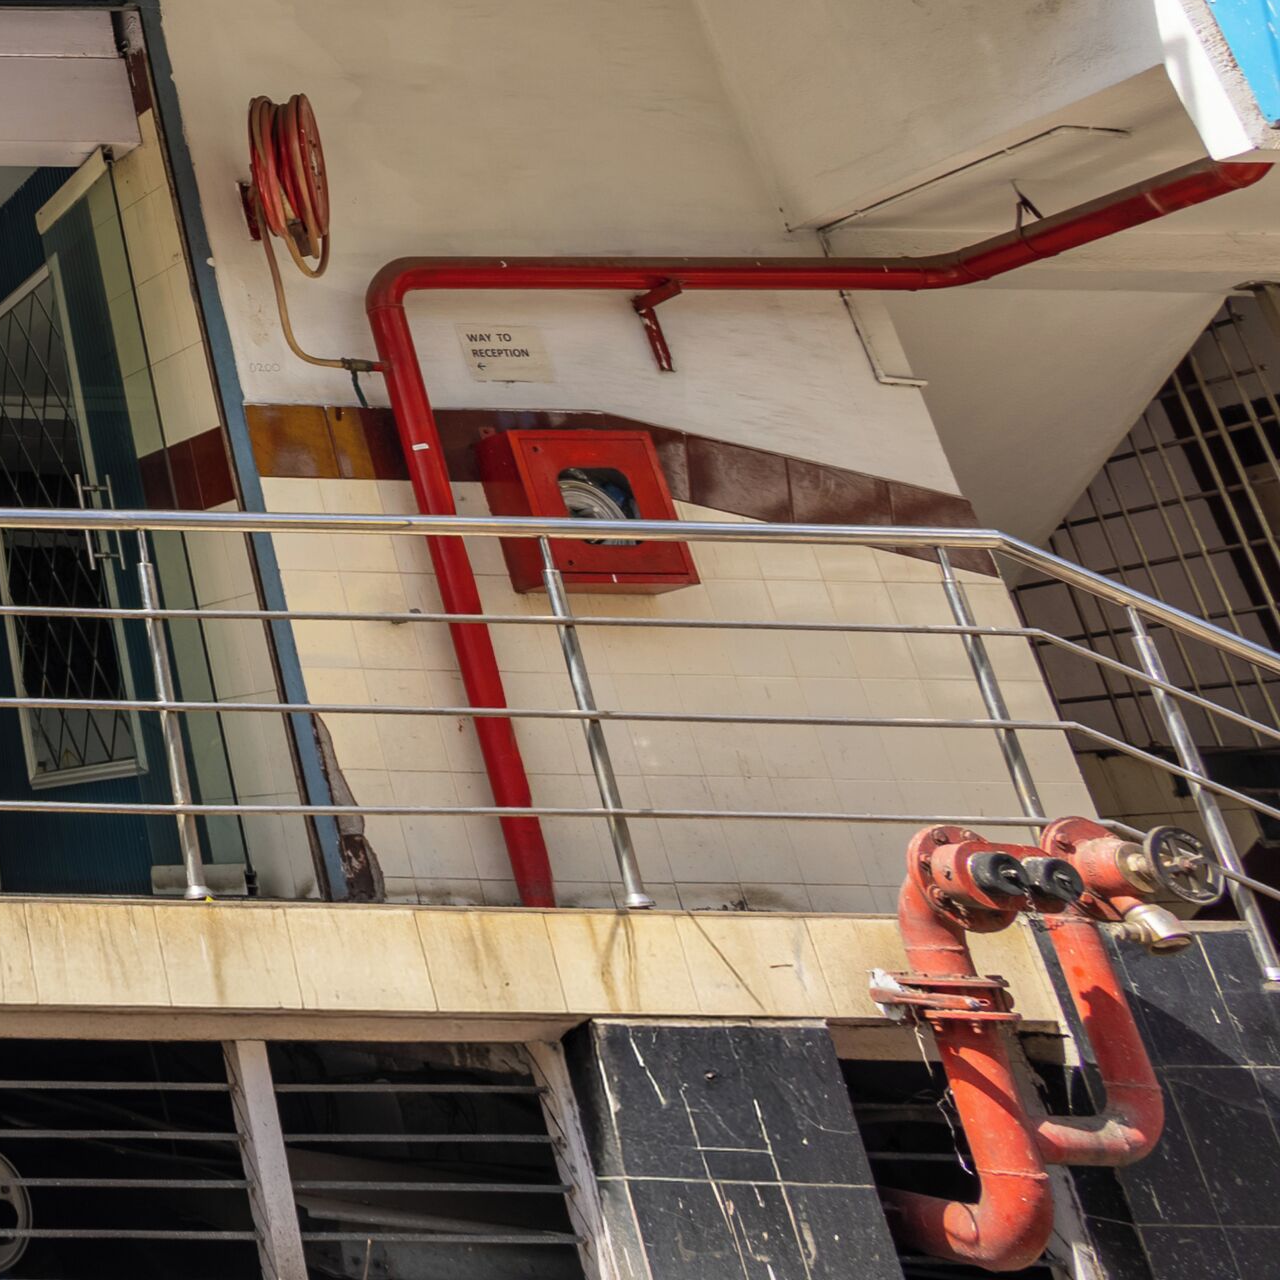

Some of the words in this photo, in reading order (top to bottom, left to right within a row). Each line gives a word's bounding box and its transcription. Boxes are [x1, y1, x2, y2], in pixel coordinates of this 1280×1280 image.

[466, 333, 491, 342] WAY
[496, 333, 512, 342] TO
[471, 348, 530, 358] RECEPTION
